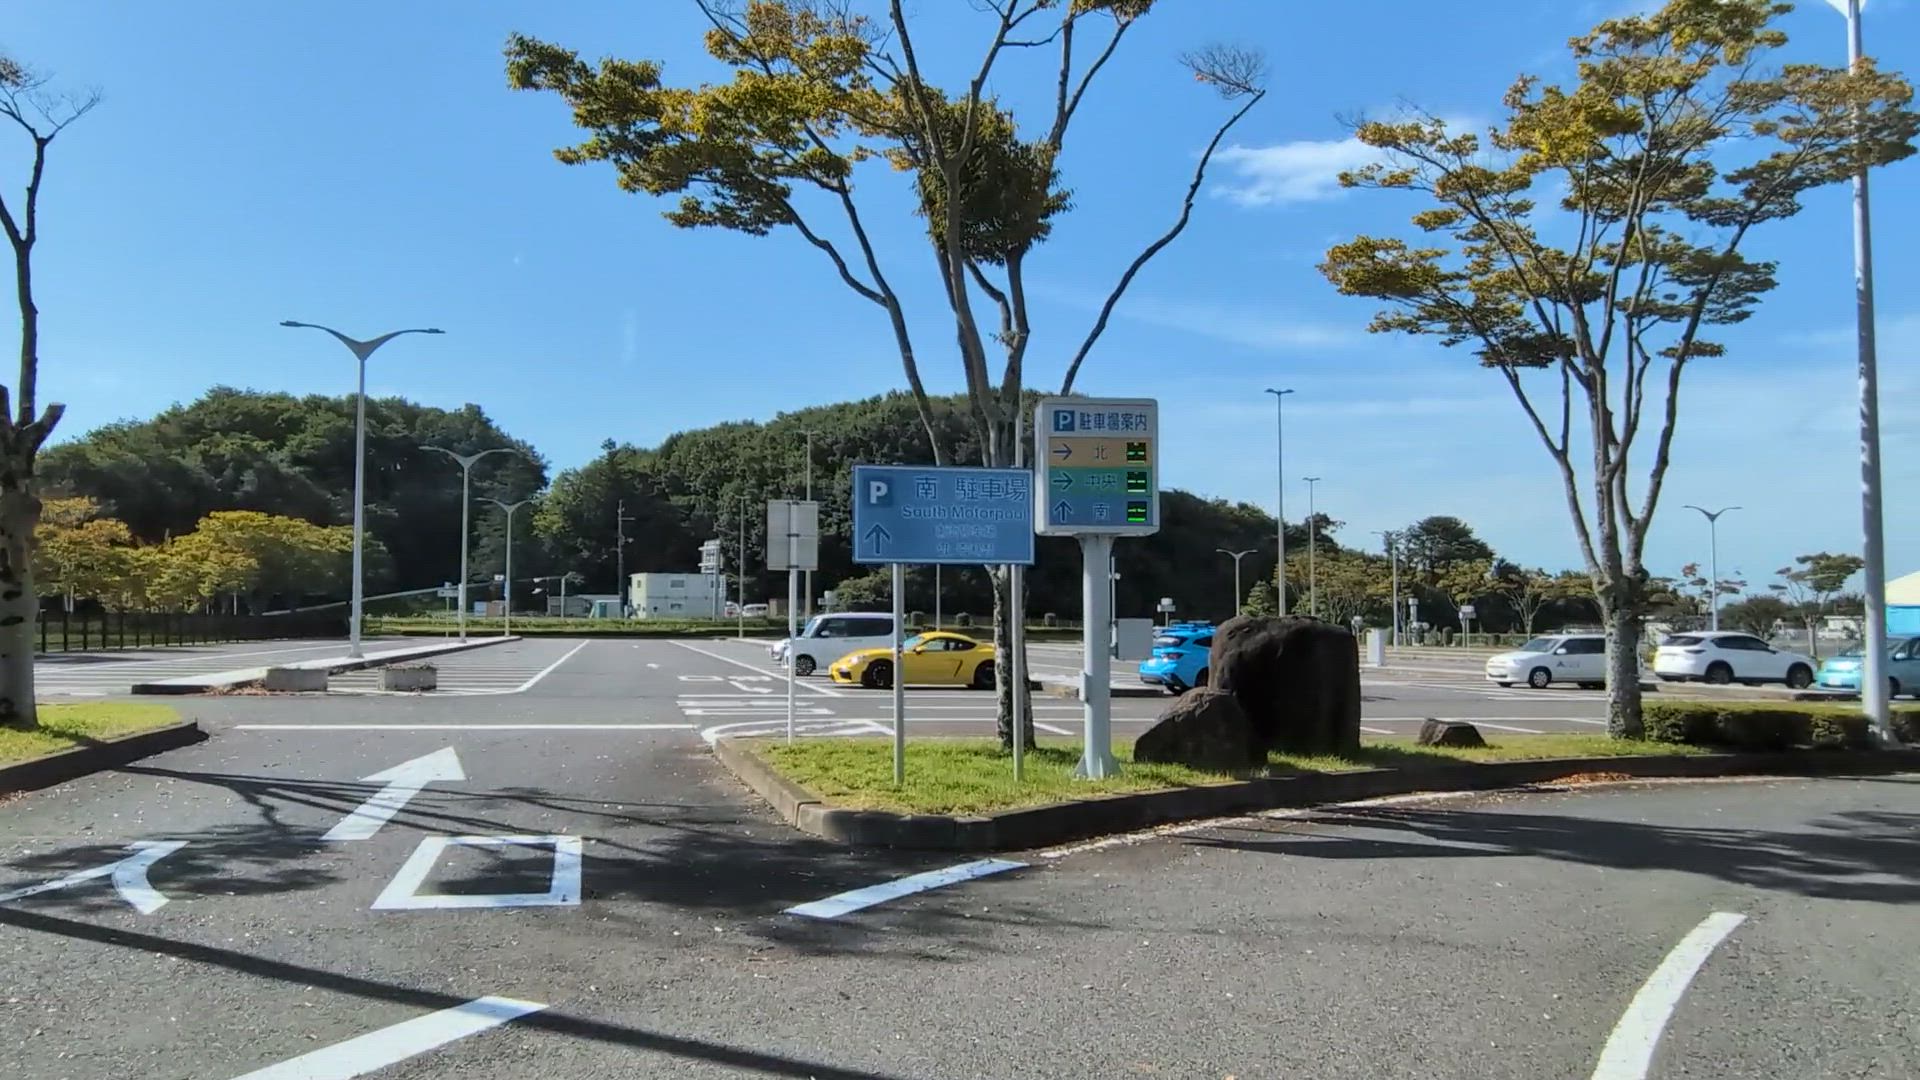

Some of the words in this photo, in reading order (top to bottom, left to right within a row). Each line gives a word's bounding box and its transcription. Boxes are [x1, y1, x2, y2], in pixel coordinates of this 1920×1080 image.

[1060, 413, 1071, 429] P
[1080, 412, 1147, 431] 駐車場案内
[1095, 445, 1108, 460] 北
[869, 480, 888, 504] P
[915, 476, 938, 500] 南
[955, 477, 1028, 501] 駐車場
[902, 505, 947, 519] South
[1092, 503, 1111, 521] 南
